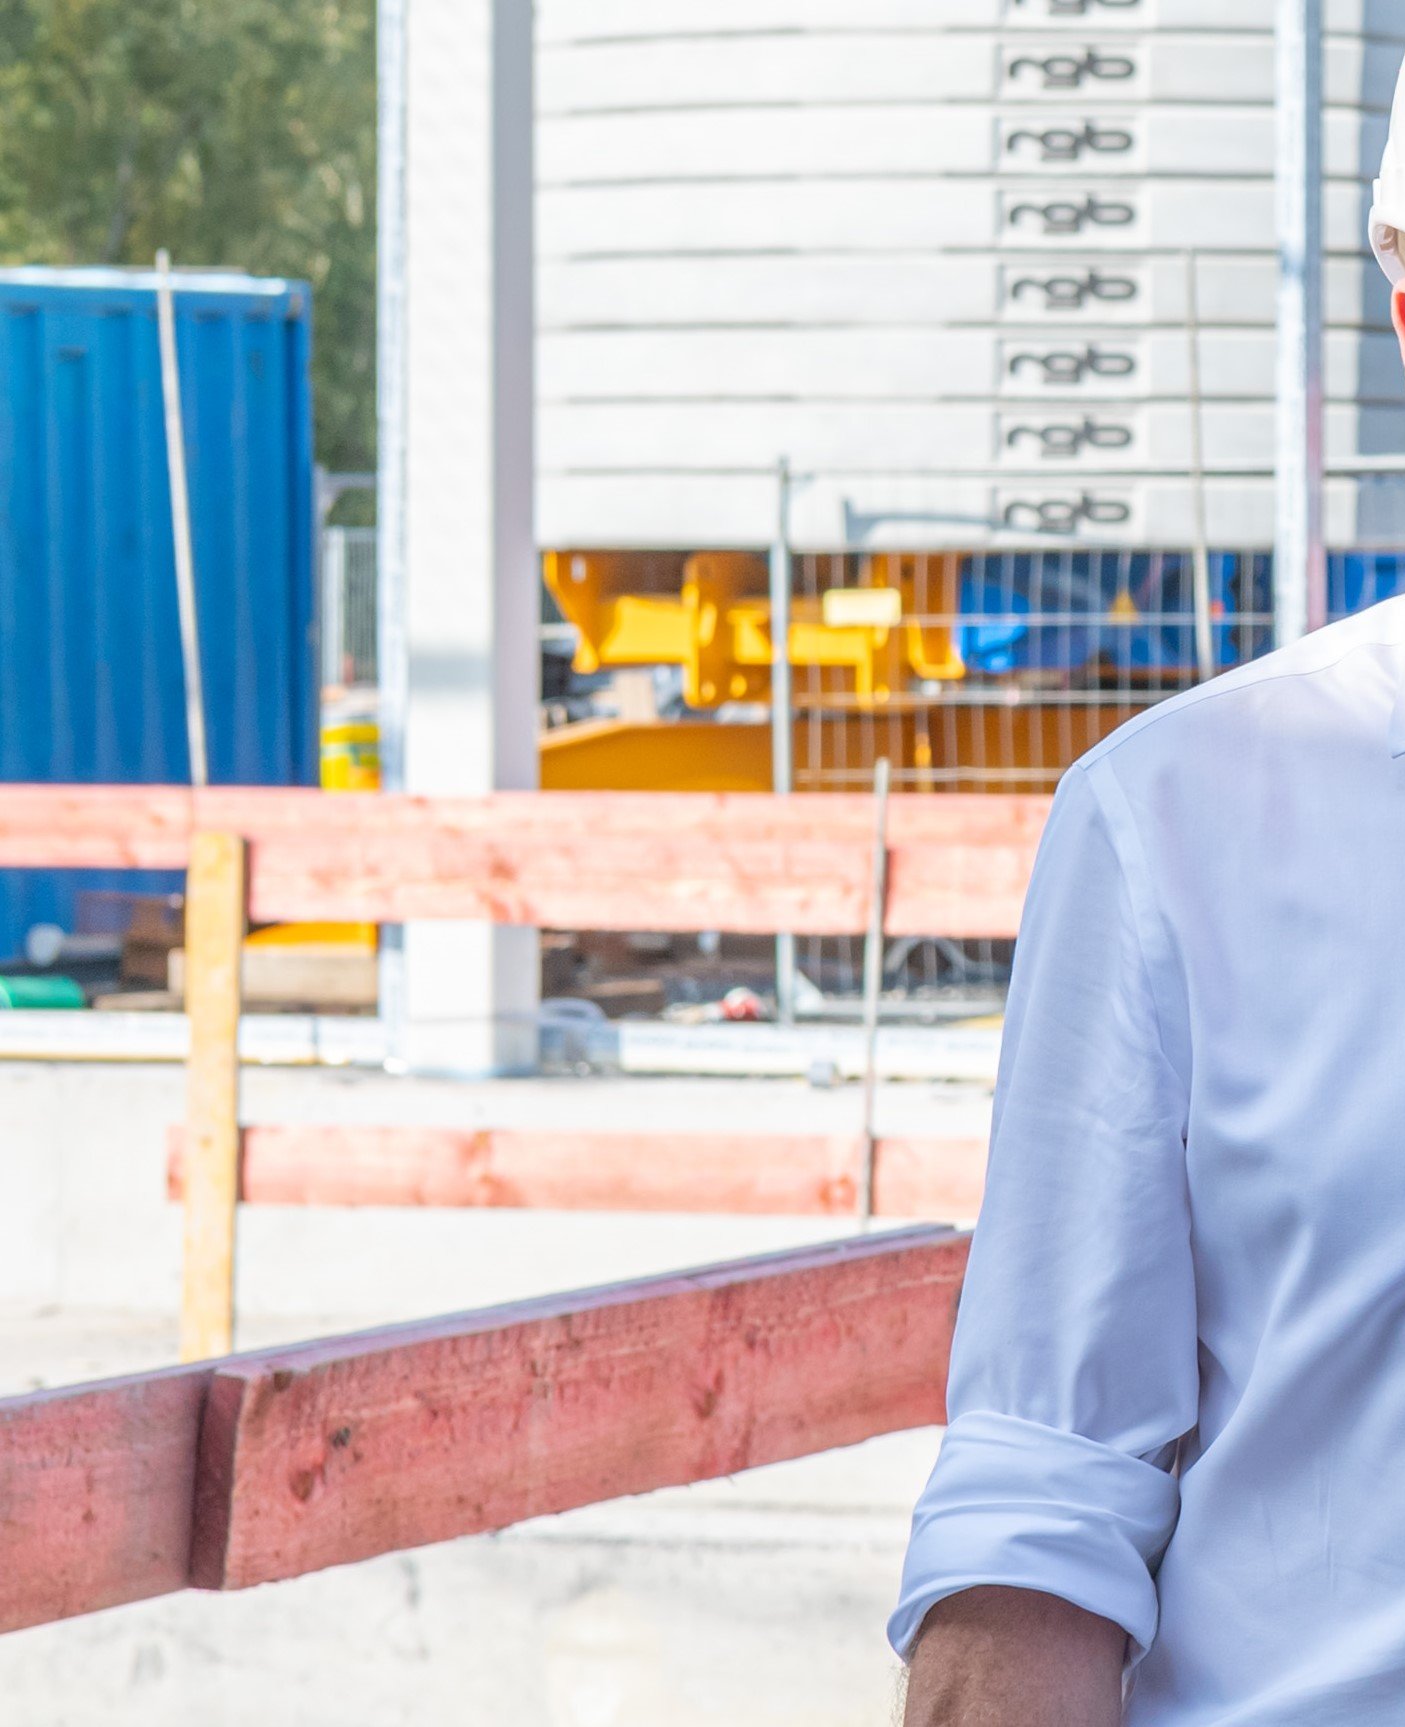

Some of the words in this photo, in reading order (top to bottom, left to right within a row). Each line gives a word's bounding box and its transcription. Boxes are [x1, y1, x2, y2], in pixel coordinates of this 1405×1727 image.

[1008, 47, 1135, 89] rgb
[1006, 121, 1133, 162] rgb
[1009, 195, 1134, 235] rgb
[1011, 268, 1137, 310] rgb
[1008, 344, 1135, 385] rgb
[1006, 417, 1132, 458] rgb
[1002, 490, 1130, 533] rgb
